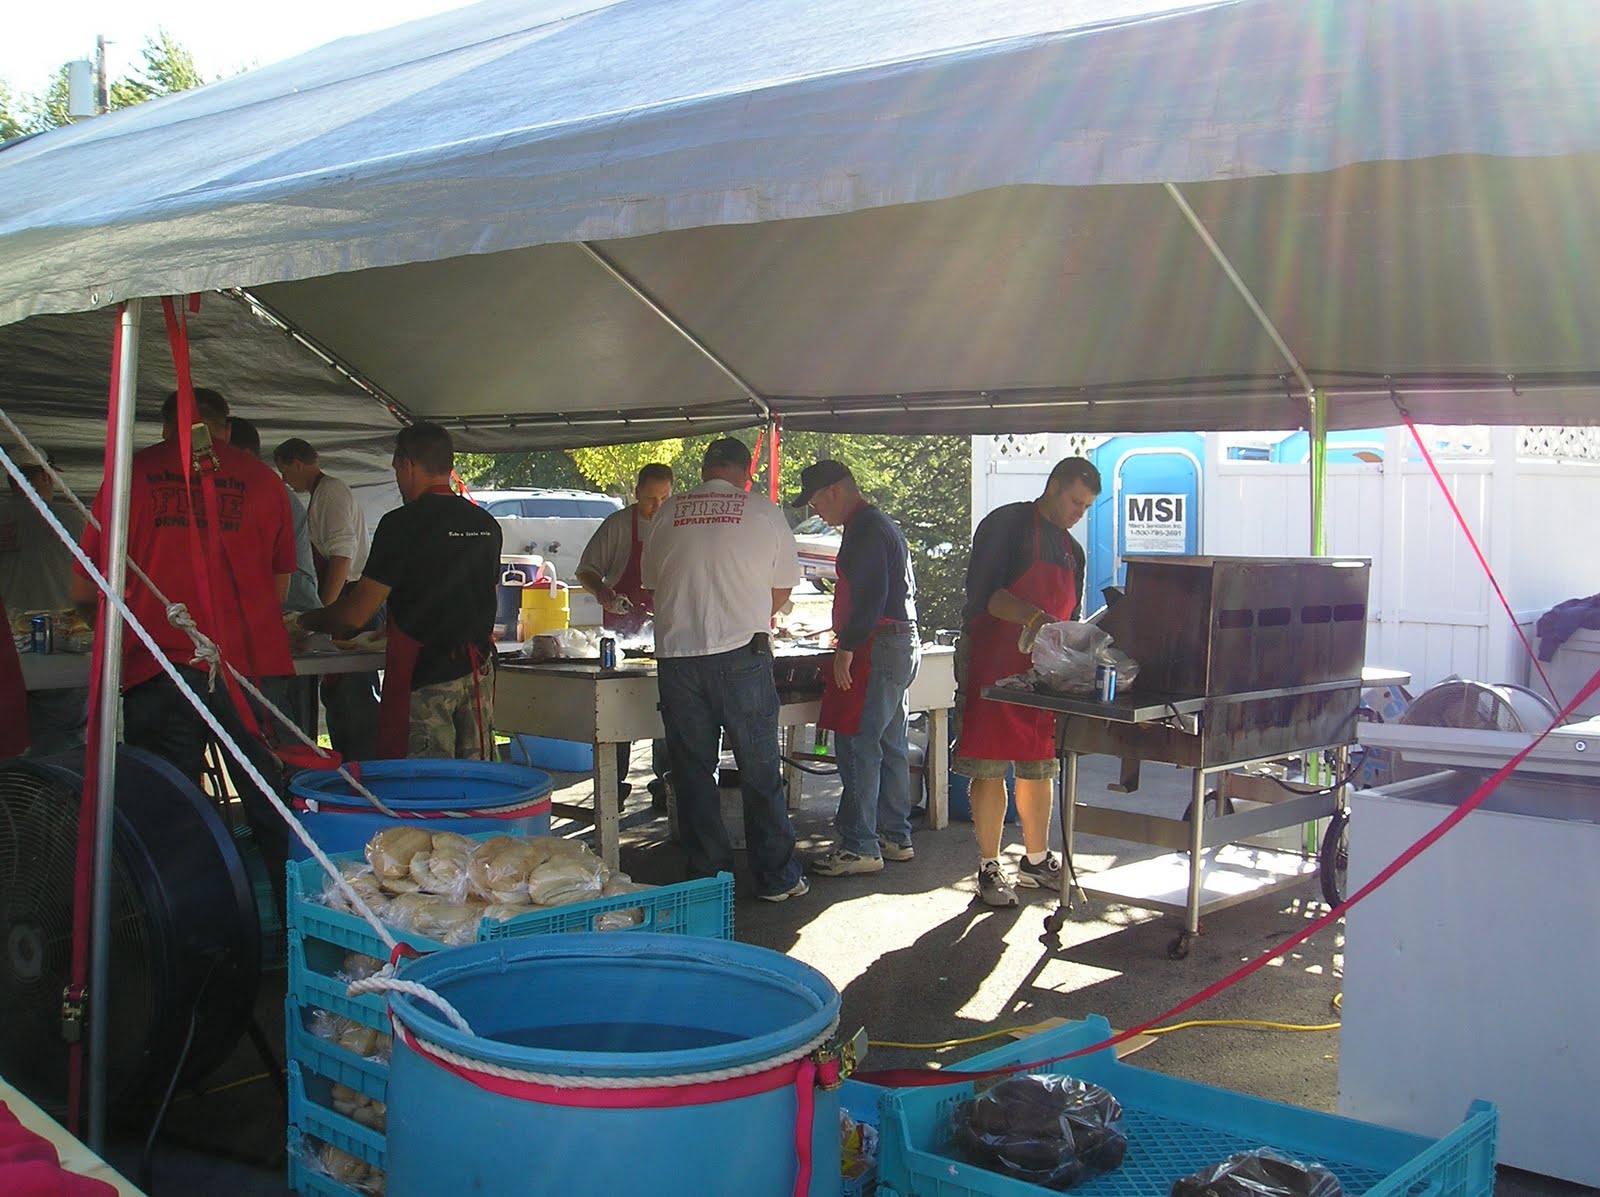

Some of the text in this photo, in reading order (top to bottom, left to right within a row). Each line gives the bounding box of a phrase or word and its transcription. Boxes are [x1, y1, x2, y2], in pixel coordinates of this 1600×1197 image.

[674, 500, 745, 519] FIRE
[1128, 497, 1183, 522] MSI
[673, 516, 742, 527] DEPARTMENT
